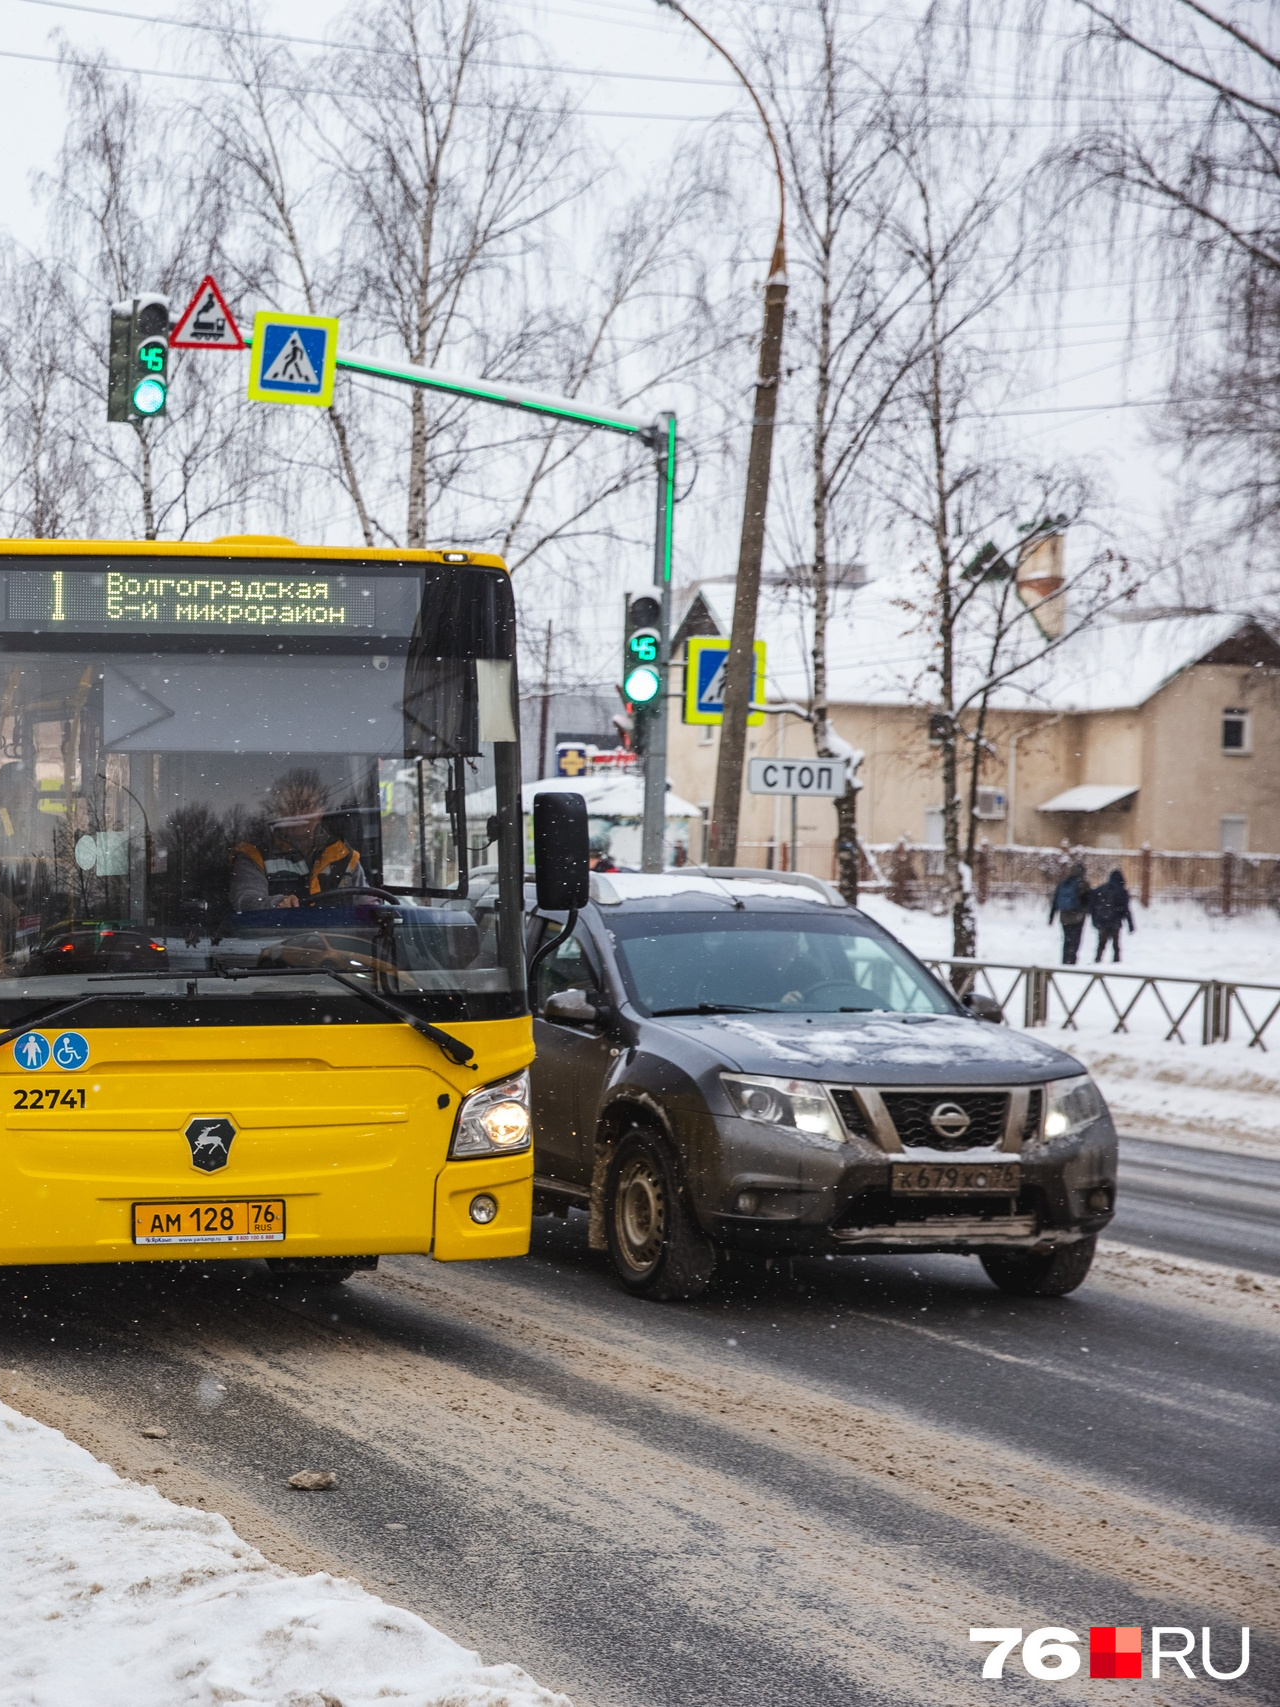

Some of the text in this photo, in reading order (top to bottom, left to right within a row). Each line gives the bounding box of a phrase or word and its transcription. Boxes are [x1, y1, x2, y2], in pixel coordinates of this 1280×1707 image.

[140, 348, 163, 371] 45
[53, 571, 65, 620] 1
[108, 572, 328, 600] Волгоградская
[108, 597, 345, 624] 5-й микрорайон
[763, 765, 832, 790] СТОП
[13, 1089, 85, 1109] 22741
[189, 1207, 234, 1232] 128
[251, 1204, 275, 1224] 76
